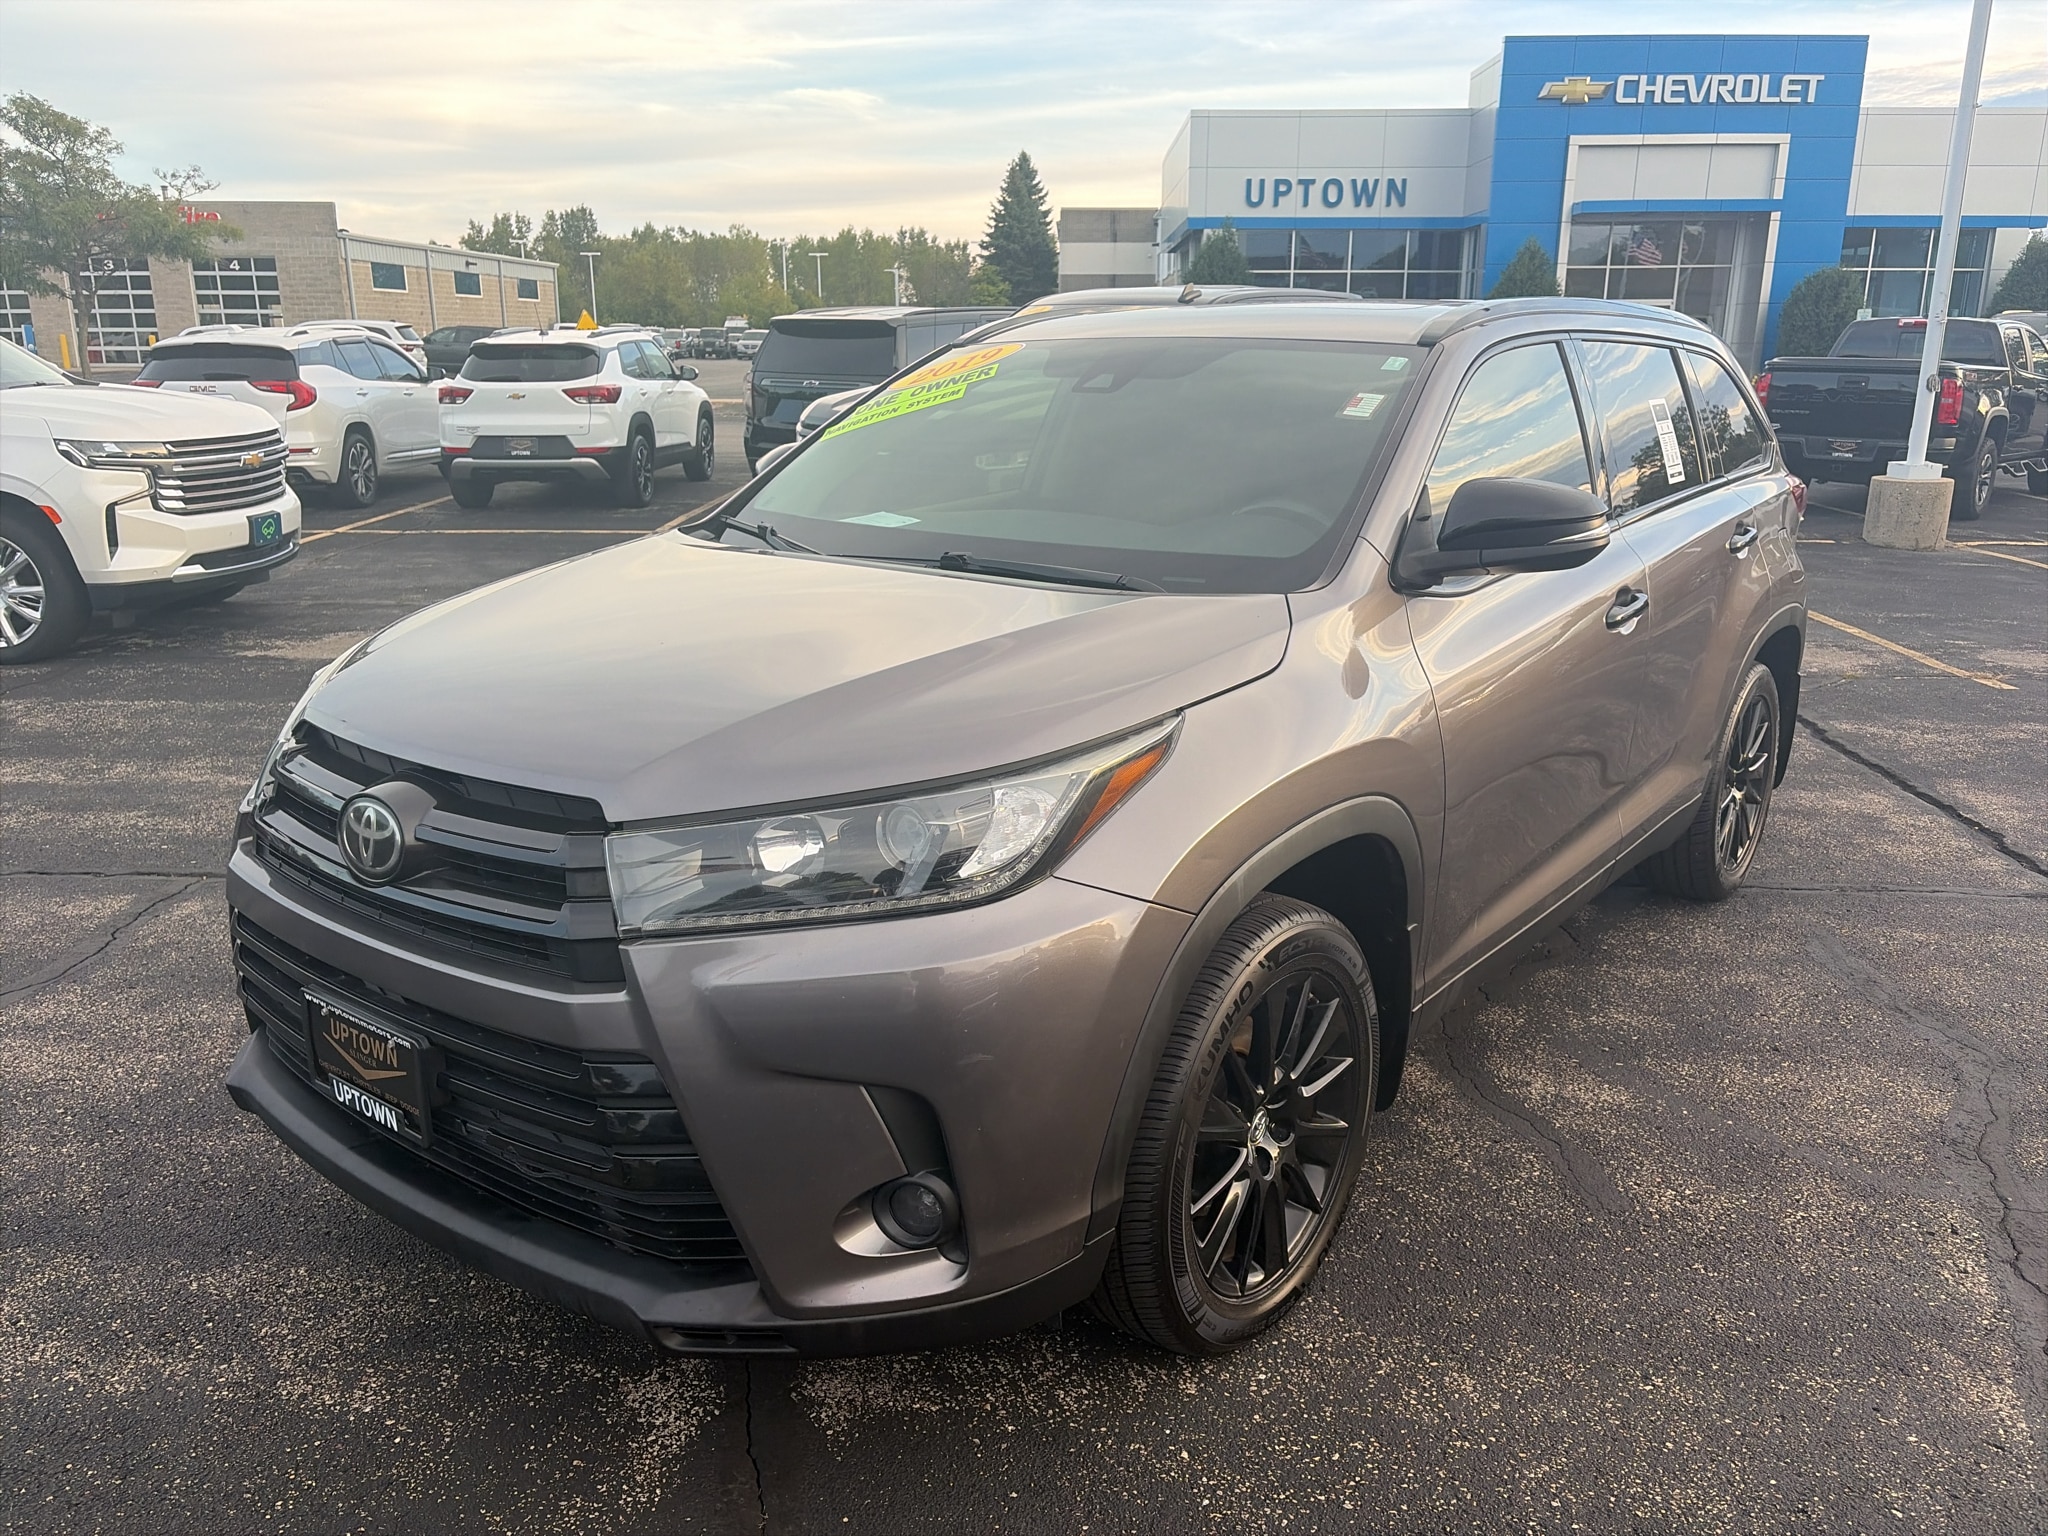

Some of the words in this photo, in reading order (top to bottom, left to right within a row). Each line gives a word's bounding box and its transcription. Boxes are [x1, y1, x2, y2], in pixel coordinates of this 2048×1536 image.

[1615, 74, 1825, 104] CHEVROLET
[1245, 178, 1408, 209] UPTOWN
[103, 259, 114, 270] 3
[229, 259, 241, 271] 4
[908, 347, 1004, 385] 2019
[189, 385, 217, 393] GMC
[855, 391, 902, 415] ONE
[911, 366, 994, 397] OWNER
[825, 406, 901, 436] NAVIGATION
[906, 388, 962, 409] SYSTEM
[330, 1017, 399, 1069] UPTOWN
[1196, 980, 1254, 1097] KUMHO
[332, 1078, 399, 1132] UPTOWN
